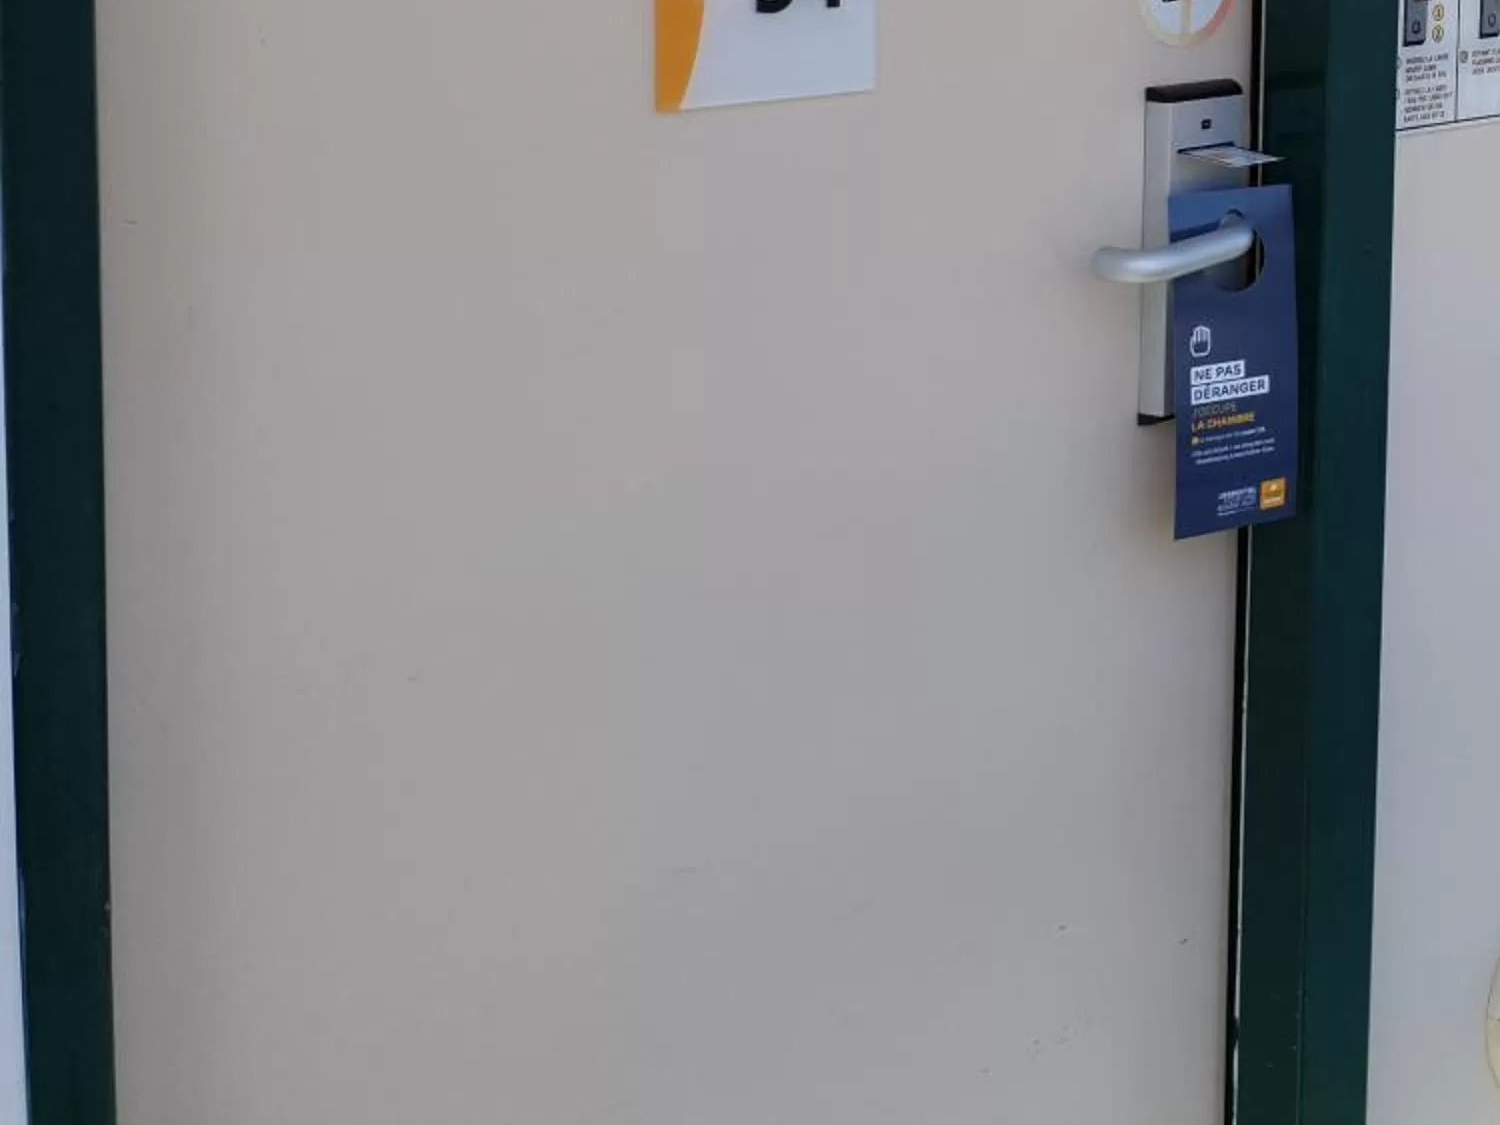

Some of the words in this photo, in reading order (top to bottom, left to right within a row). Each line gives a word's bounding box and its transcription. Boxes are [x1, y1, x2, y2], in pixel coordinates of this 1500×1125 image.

[1193, 366, 1212, 382] NE
[1215, 363, 1242, 379] PAS
[1193, 378, 1266, 401] DÉRANGER
[1191, 420, 1205, 434] LA
